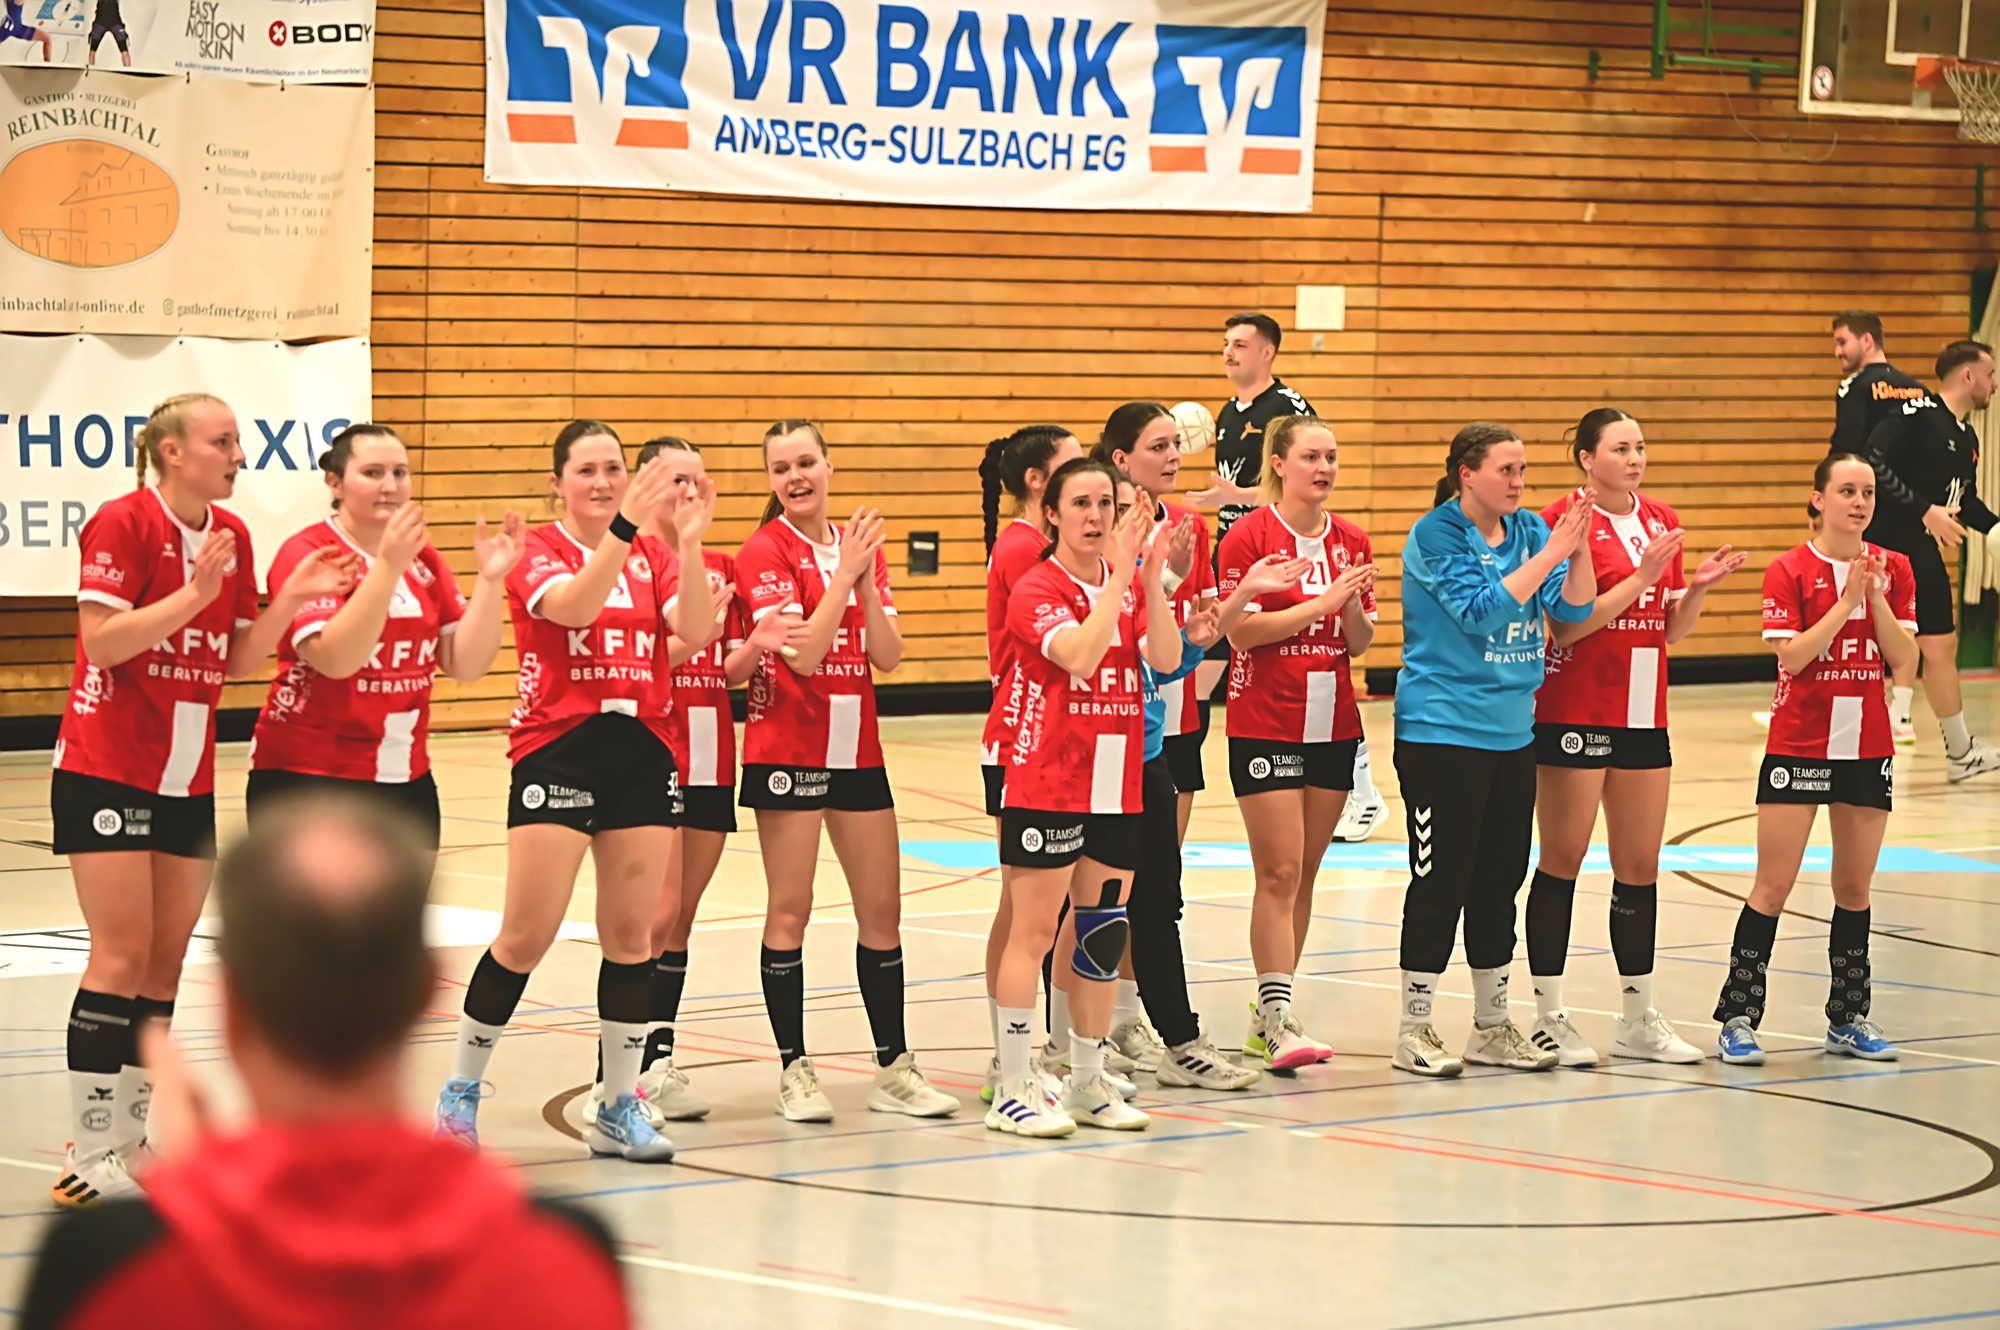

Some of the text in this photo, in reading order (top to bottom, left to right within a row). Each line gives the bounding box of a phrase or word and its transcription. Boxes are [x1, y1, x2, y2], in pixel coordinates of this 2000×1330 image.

[200, 40, 233, 61] SKIN
[716, 0, 1131, 119] VR BANK
[7, 107, 161, 148] REINBACHTAL
[714, 114, 1126, 172] AMBERG-SULZBACH EG
[1305, 560, 1328, 586] 21
[1607, 618, 1665, 631] BERATU
[568, 628, 656, 660] KFM
[570, 666, 654, 683] BERATUN
[1564, 735, 1579, 750] 89
[1252, 761, 1266, 775] 89
[1792, 767, 1832, 779] TEAMSHOP
[772, 775, 788, 791] 89
[98, 814, 117, 831] 89
[1025, 832, 1040, 847] 89
